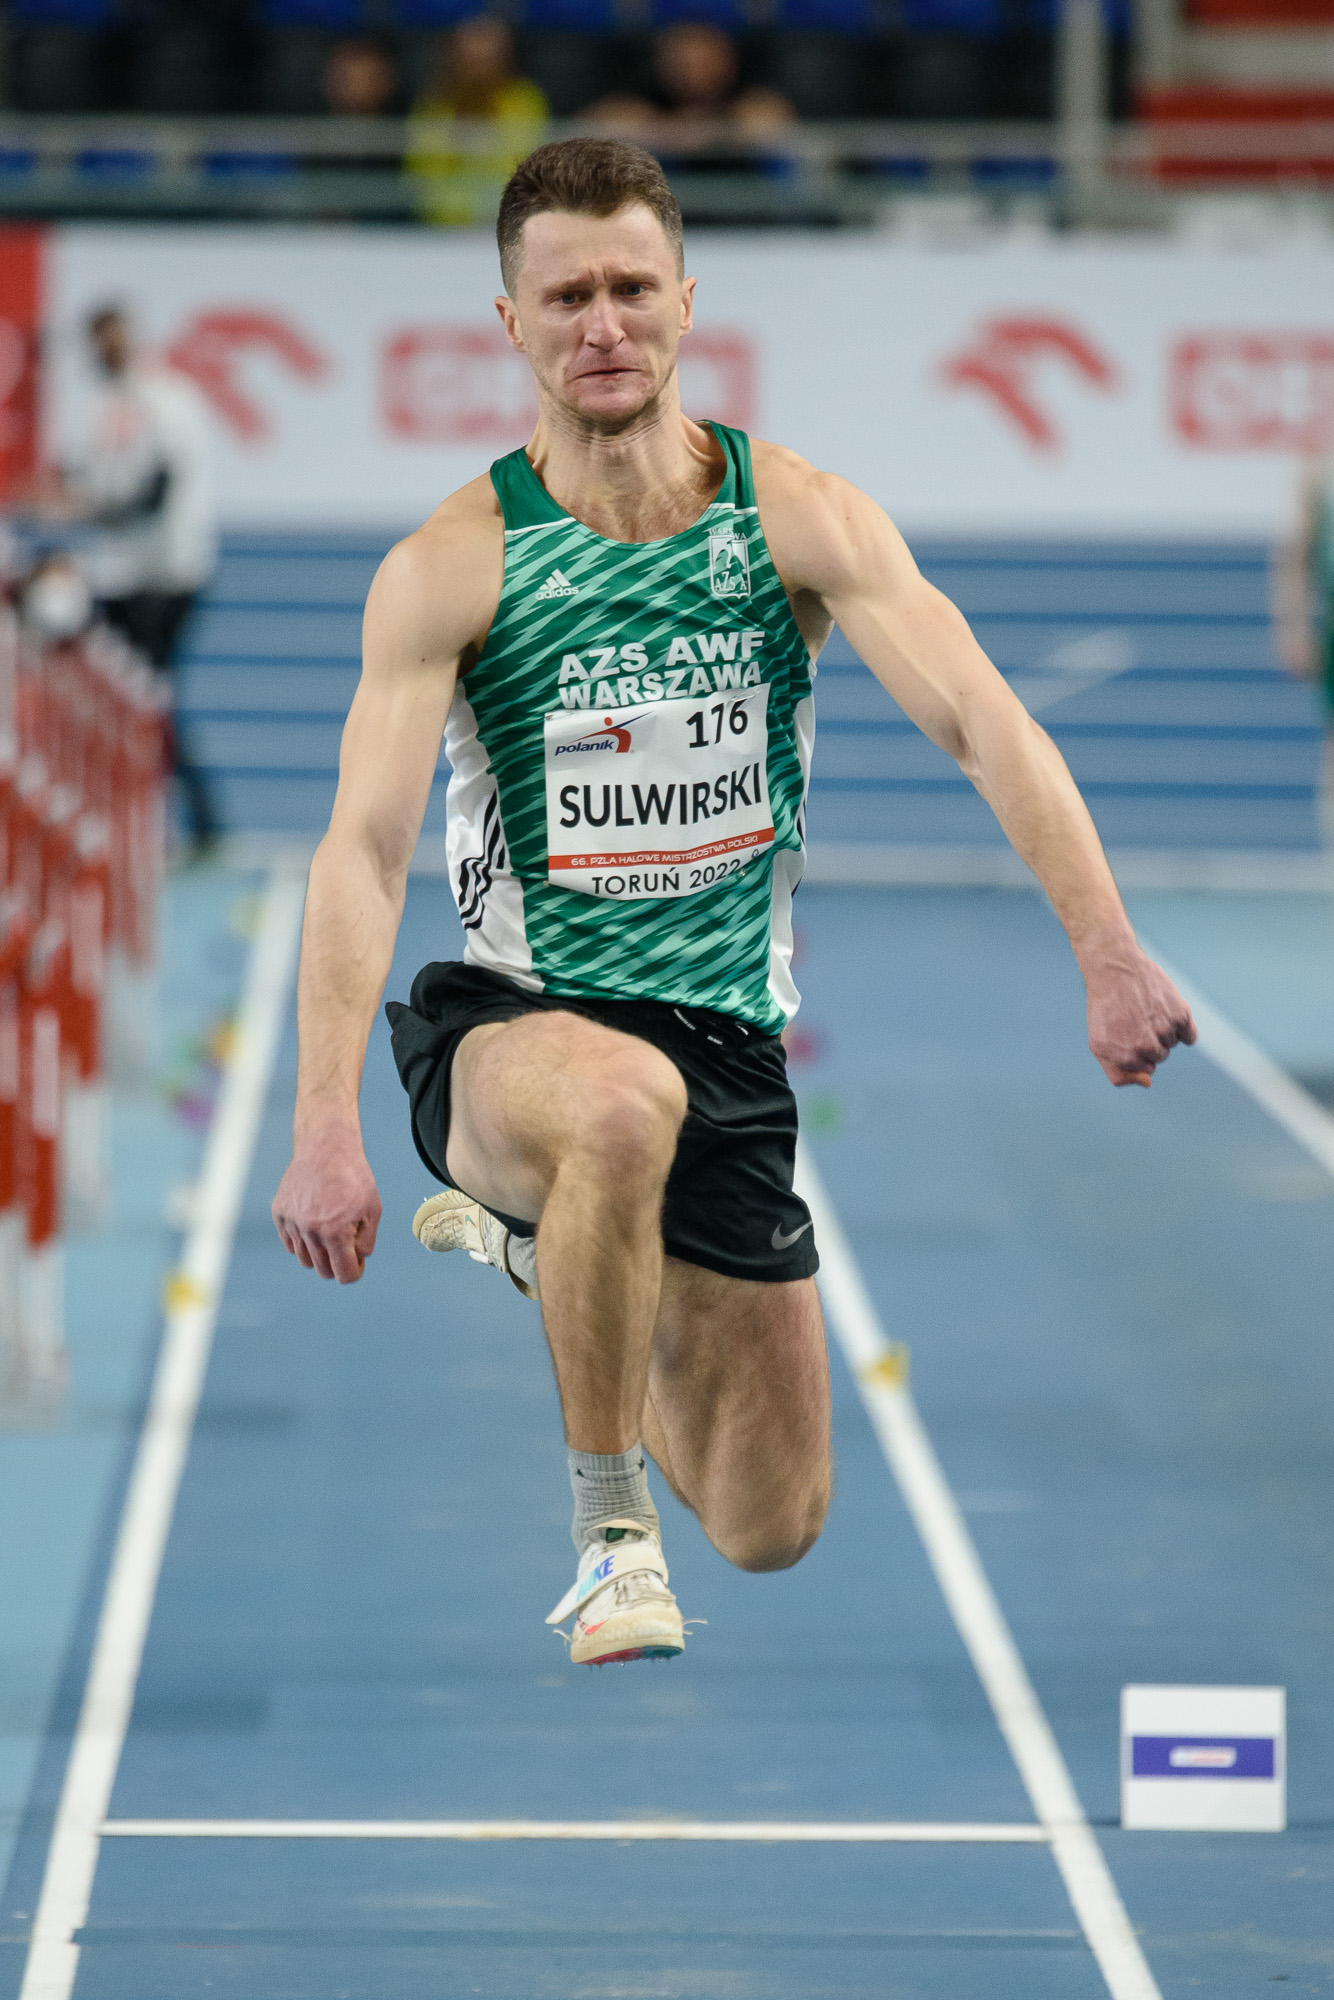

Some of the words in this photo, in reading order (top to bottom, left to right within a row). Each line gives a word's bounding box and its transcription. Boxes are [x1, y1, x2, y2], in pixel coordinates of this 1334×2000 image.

[534, 584, 580, 601] adidas
[557, 642, 649, 685] AZS
[665, 631, 766, 666] AWF
[558, 662, 762, 710] WARSZAWA
[686, 698, 750, 749] 176
[554, 739, 615, 757] polanik
[559, 762, 763, 829] SULWIRSKI
[570, 857, 590, 866] 66.
[590, 856, 618, 866] PZLA
[618, 854, 661, 865] HALOWE
[661, 843, 727, 863] MISTRZOSTWA
[727, 834, 759, 850] POLSKI
[591, 866, 680, 896] TORUŃ
[689, 858, 742, 890] 2022
